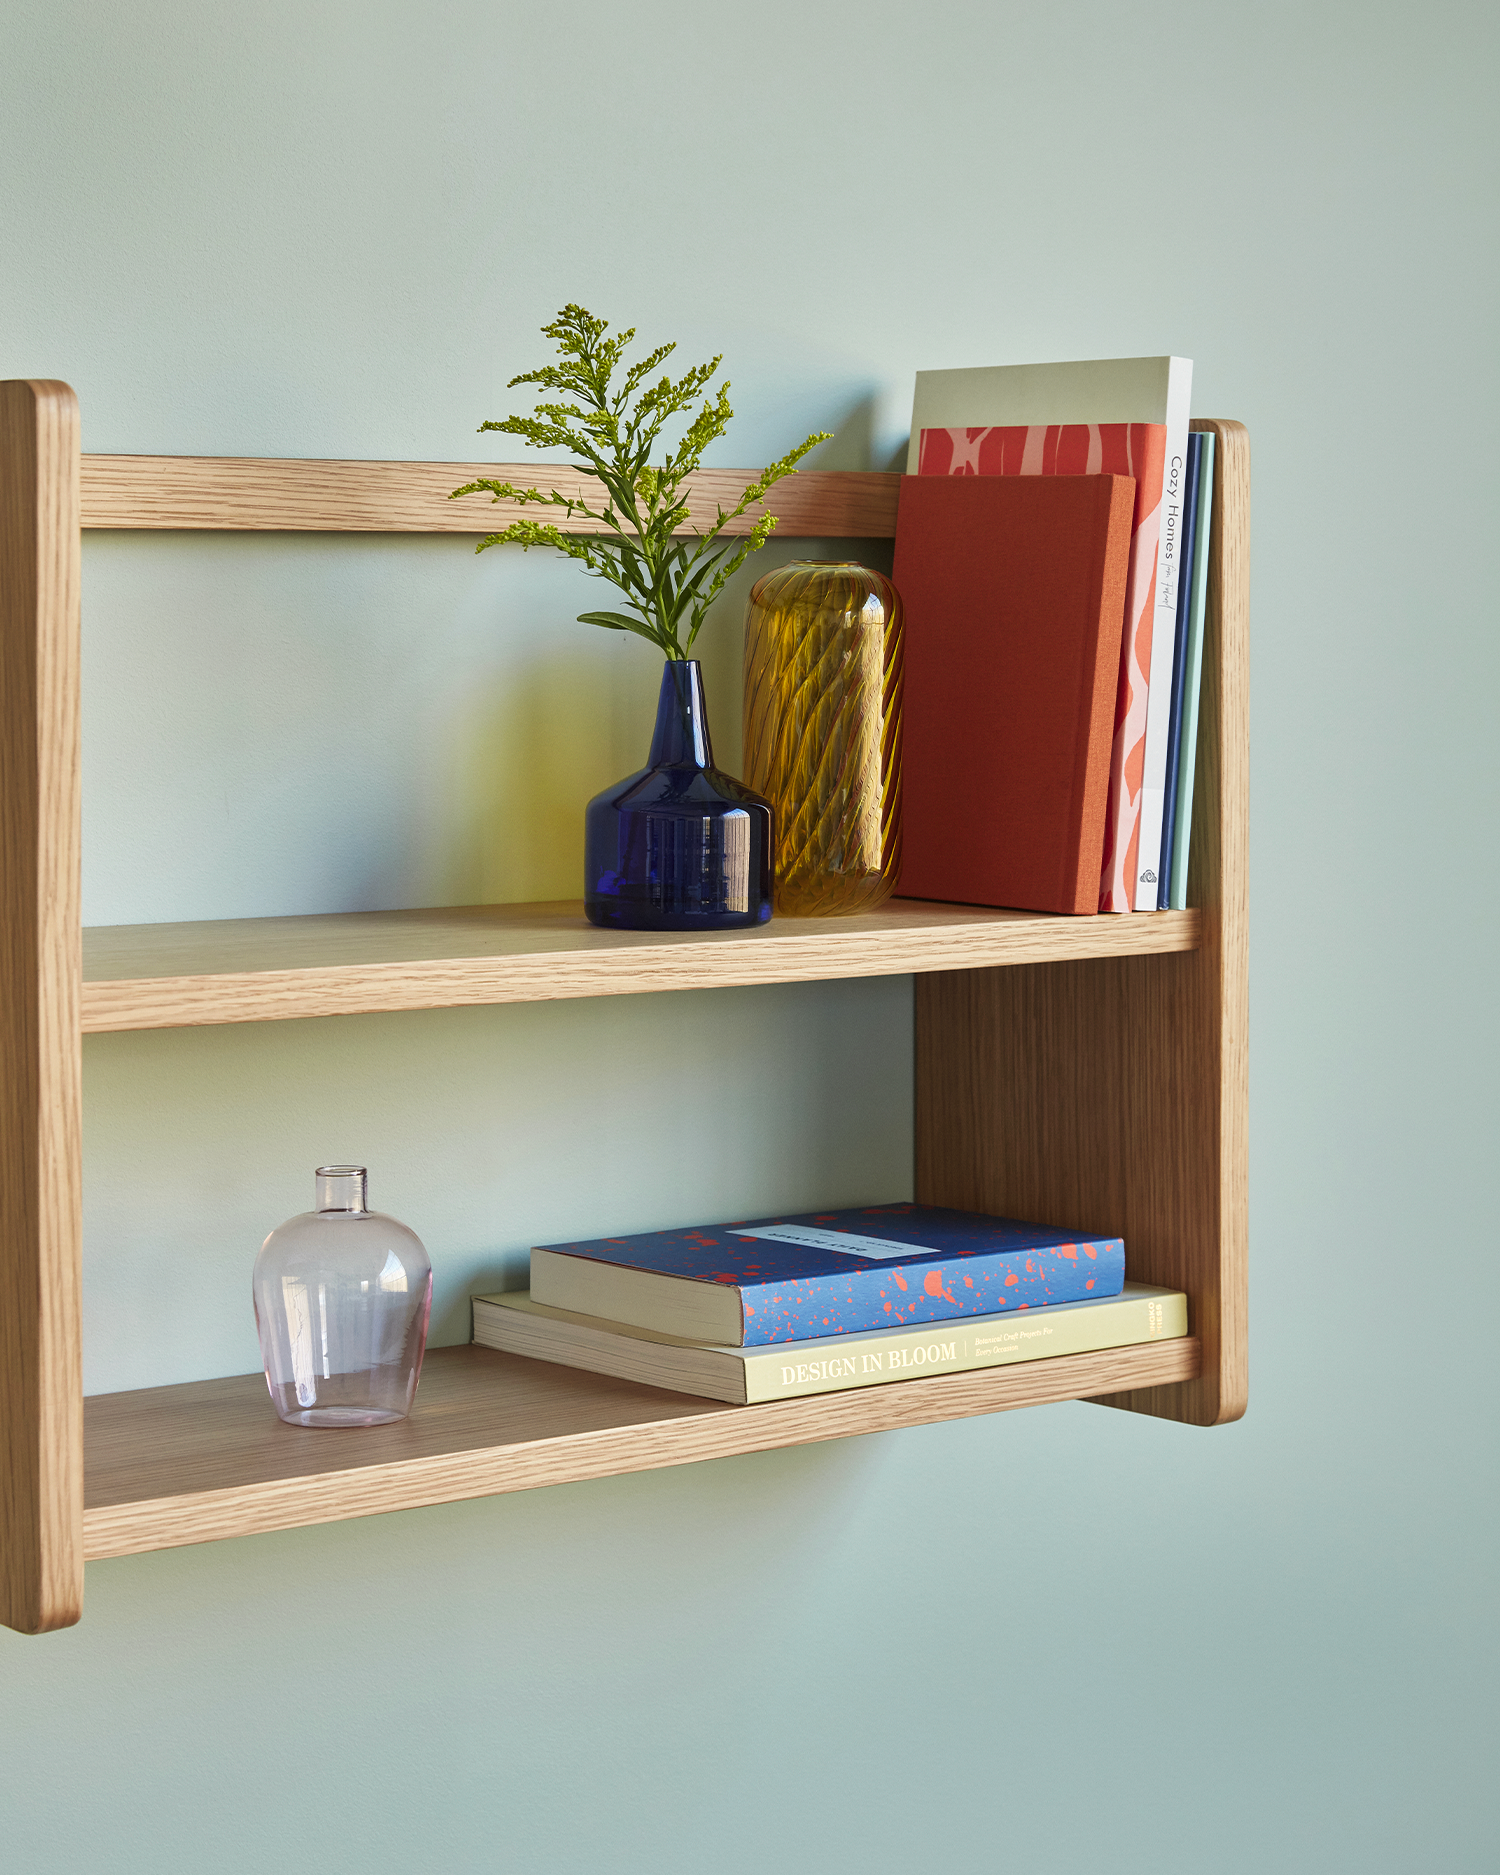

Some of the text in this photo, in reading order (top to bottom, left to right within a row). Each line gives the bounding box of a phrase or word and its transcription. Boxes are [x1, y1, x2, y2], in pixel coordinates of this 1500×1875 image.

[1166, 455, 1183, 498] Cozy
[1165, 504, 1179, 560] Homes
[974, 1327, 1054, 1346] Botanical Craft Projects For
[1155, 1303, 1163, 1334] PRESS
[780, 1341, 957, 1385] DESIGN IN BLOOM
[975, 1344, 1019, 1357] Every Occasion
